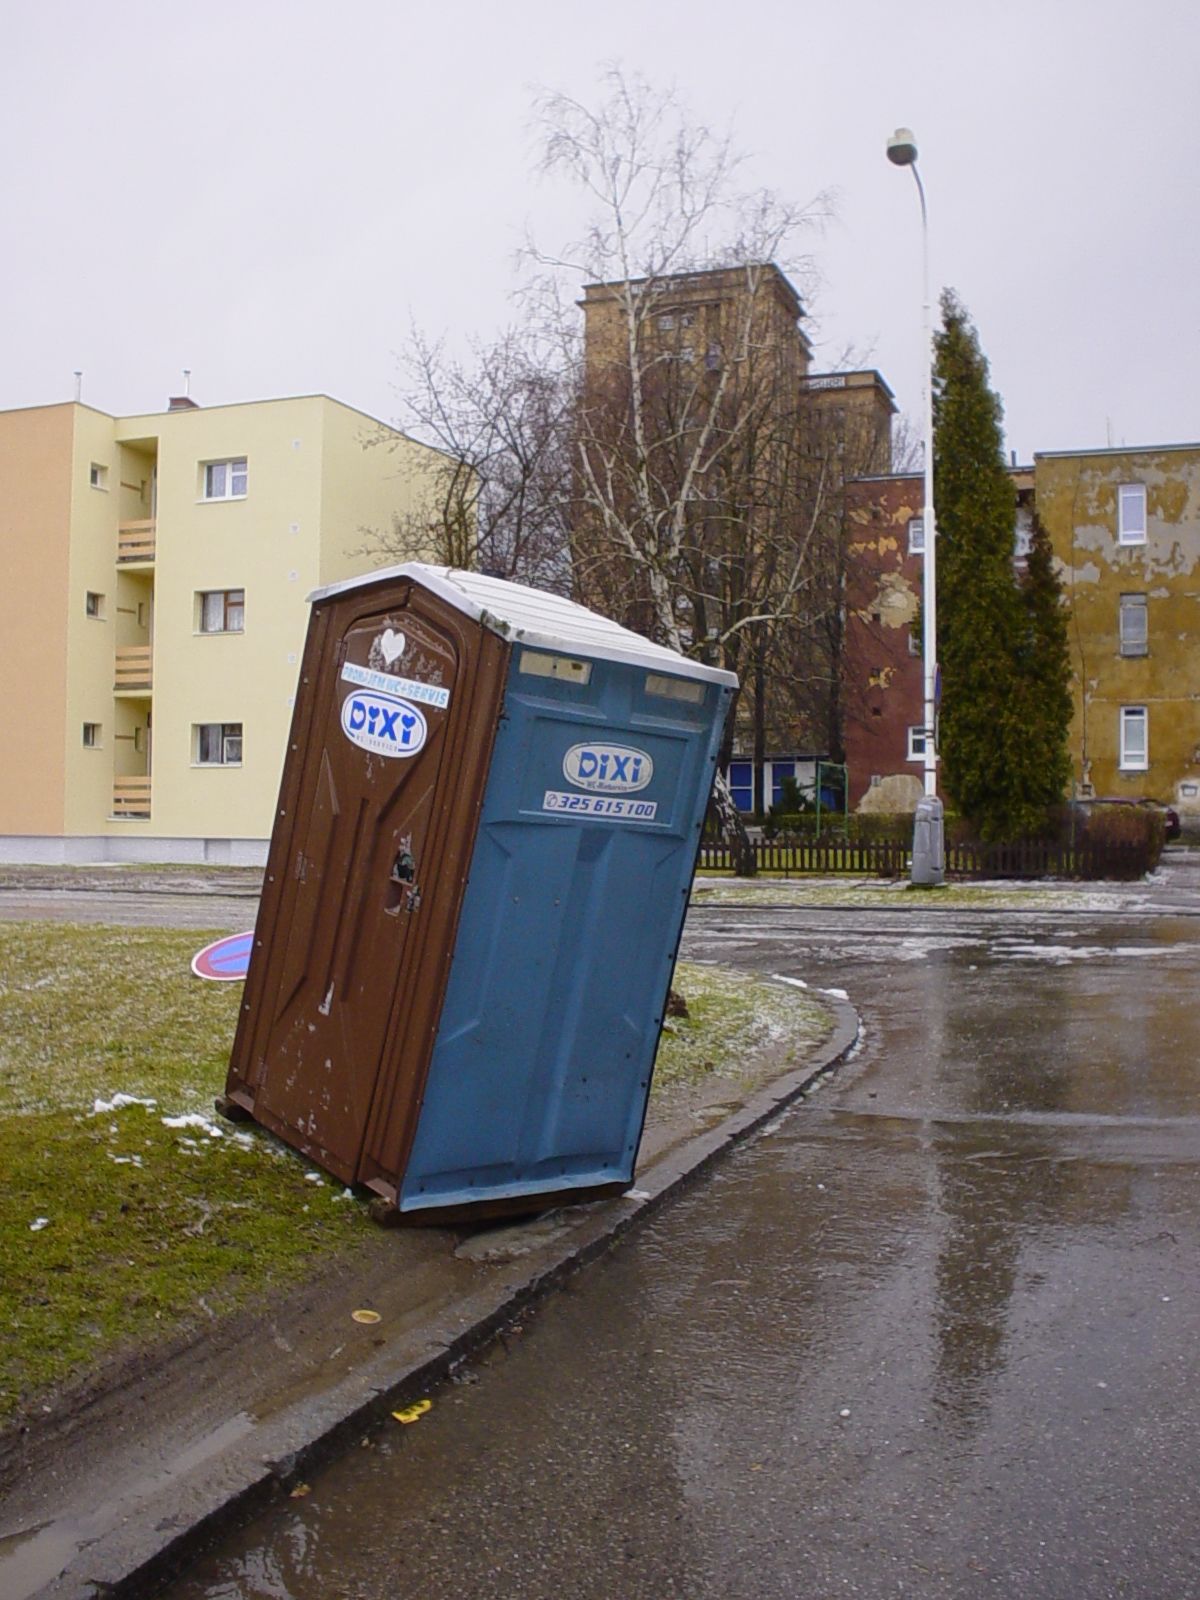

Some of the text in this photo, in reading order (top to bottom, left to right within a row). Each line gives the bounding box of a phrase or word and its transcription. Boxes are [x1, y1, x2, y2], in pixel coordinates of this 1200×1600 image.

[558, 795, 654, 817] 325 615 100
